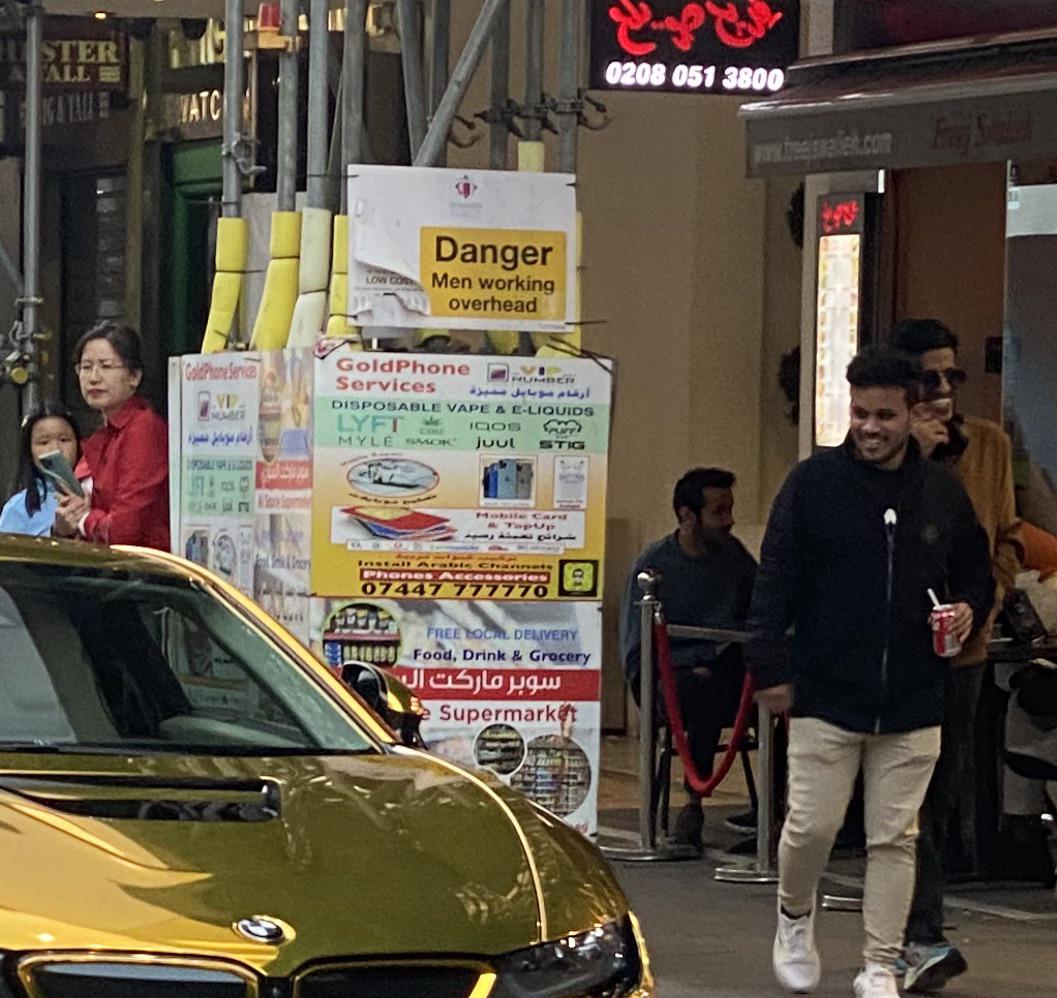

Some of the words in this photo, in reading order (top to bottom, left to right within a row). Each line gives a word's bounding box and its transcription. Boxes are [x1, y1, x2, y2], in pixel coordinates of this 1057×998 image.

[605, 61, 666, 85] 0208
[672, 64, 716, 87] 051
[722, 67, 784, 91] 3800
[435, 235, 553, 271] Danger
[432, 274, 472, 289] Men
[479, 276, 555, 294] working
[449, 295, 537, 313] overhead
[335, 357, 470, 376] GoldPhone
[336, 376, 436, 393] Services
[512, 376, 575, 384] NUMBER
[332, 400, 442, 413] DISPOSABLE
[447, 403, 490, 414] VAPE
[495, 405, 506, 415] &
[512, 405, 594, 417] E-LIQUIDS
[337, 414, 404, 433] LYFT
[539, 440, 585, 450] STIG
[475, 512, 526, 520] Mobile
[505, 523, 556, 531] TopUp
[358, 560, 411, 569] Install
[417, 561, 473, 569] Arabic
[478, 562, 554, 571] Channels
[362, 570, 433, 580] Phones
[439, 571, 549, 583] Accessories
[361, 583, 442, 597] 07447
[454, 584, 549, 598] 777770
[426, 627, 461, 640] FREE
[465, 628, 510, 641] LOCAL
[513, 628, 578, 641] DELIVERY
[413, 649, 458, 663] Food,
[463, 649, 507, 661] Drink
[512, 650, 523, 661] &
[529, 650, 591, 666] Grocery
[430, 668, 503, 695] ماركت
[508, 674, 561, 695] سوبر
[440, 704, 578, 724] Supermarket
